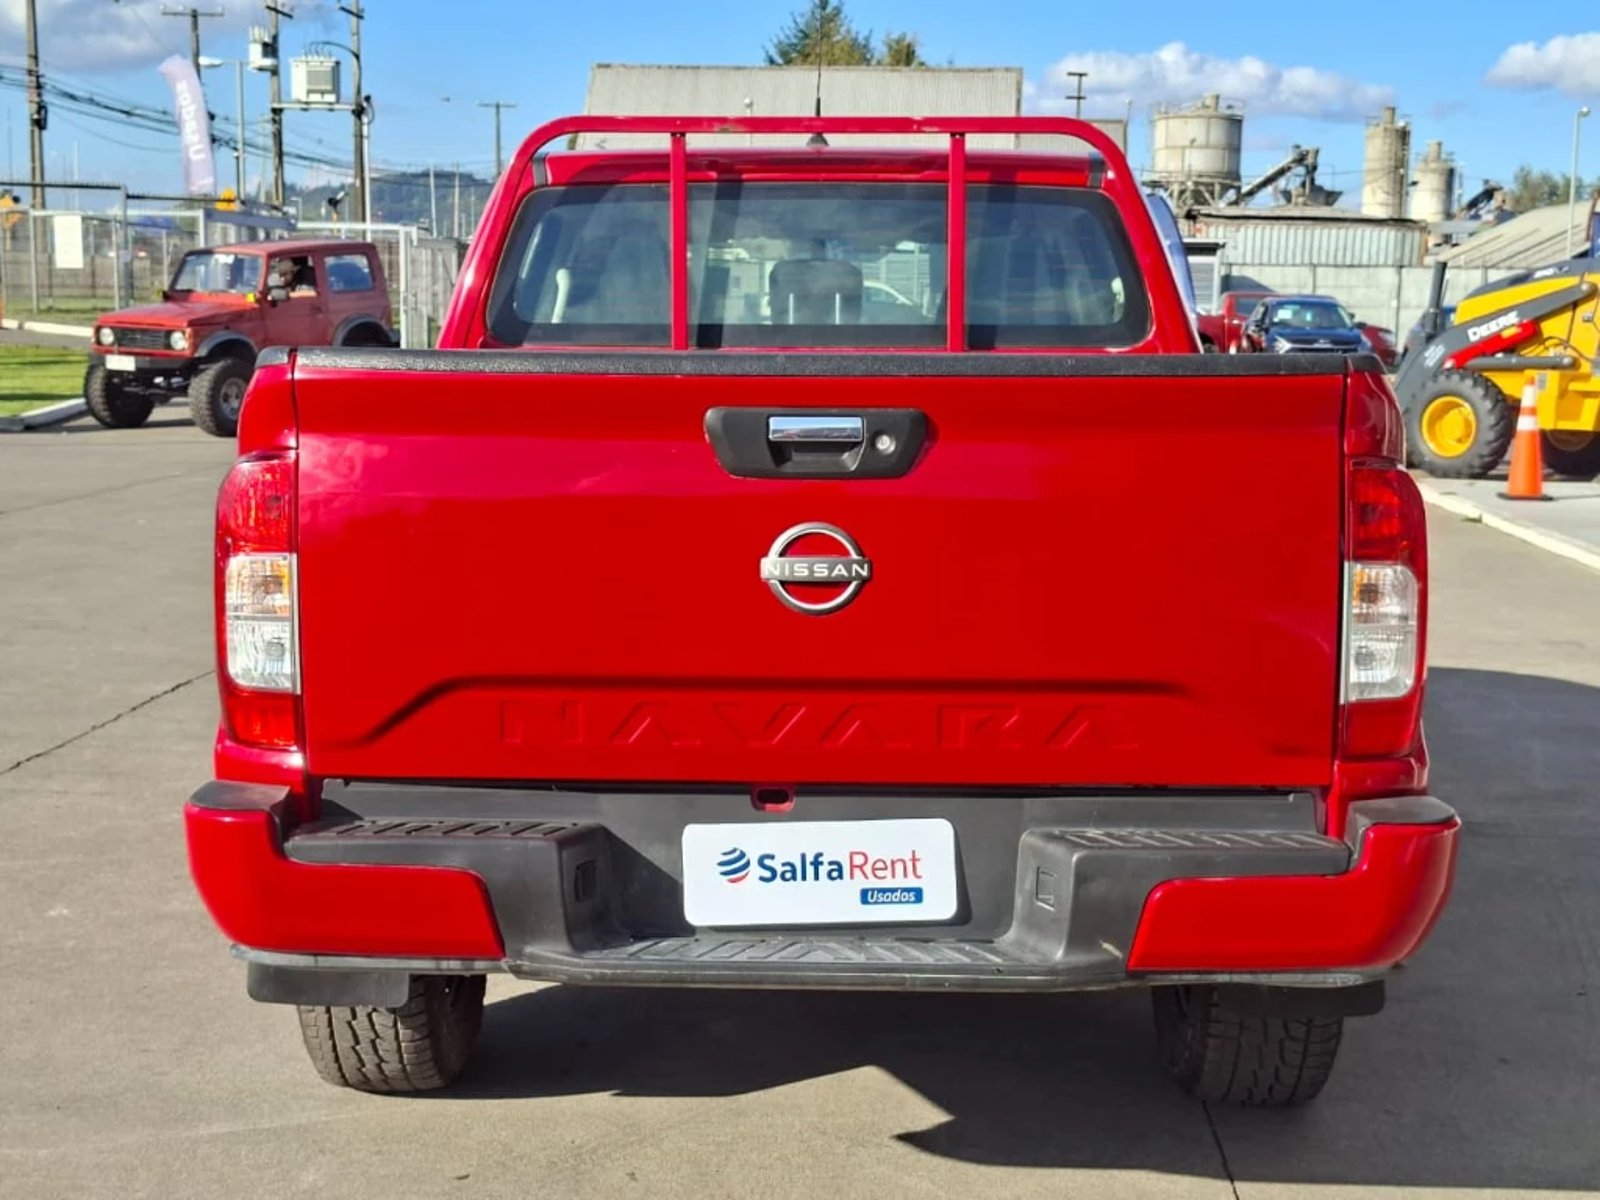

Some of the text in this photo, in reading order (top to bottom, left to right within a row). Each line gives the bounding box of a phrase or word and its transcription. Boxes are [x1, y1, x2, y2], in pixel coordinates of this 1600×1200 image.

[764, 562, 868, 577] NISSAN
[499, 700, 1139, 748] NAVARA
[867, 889, 916, 903] Usados
